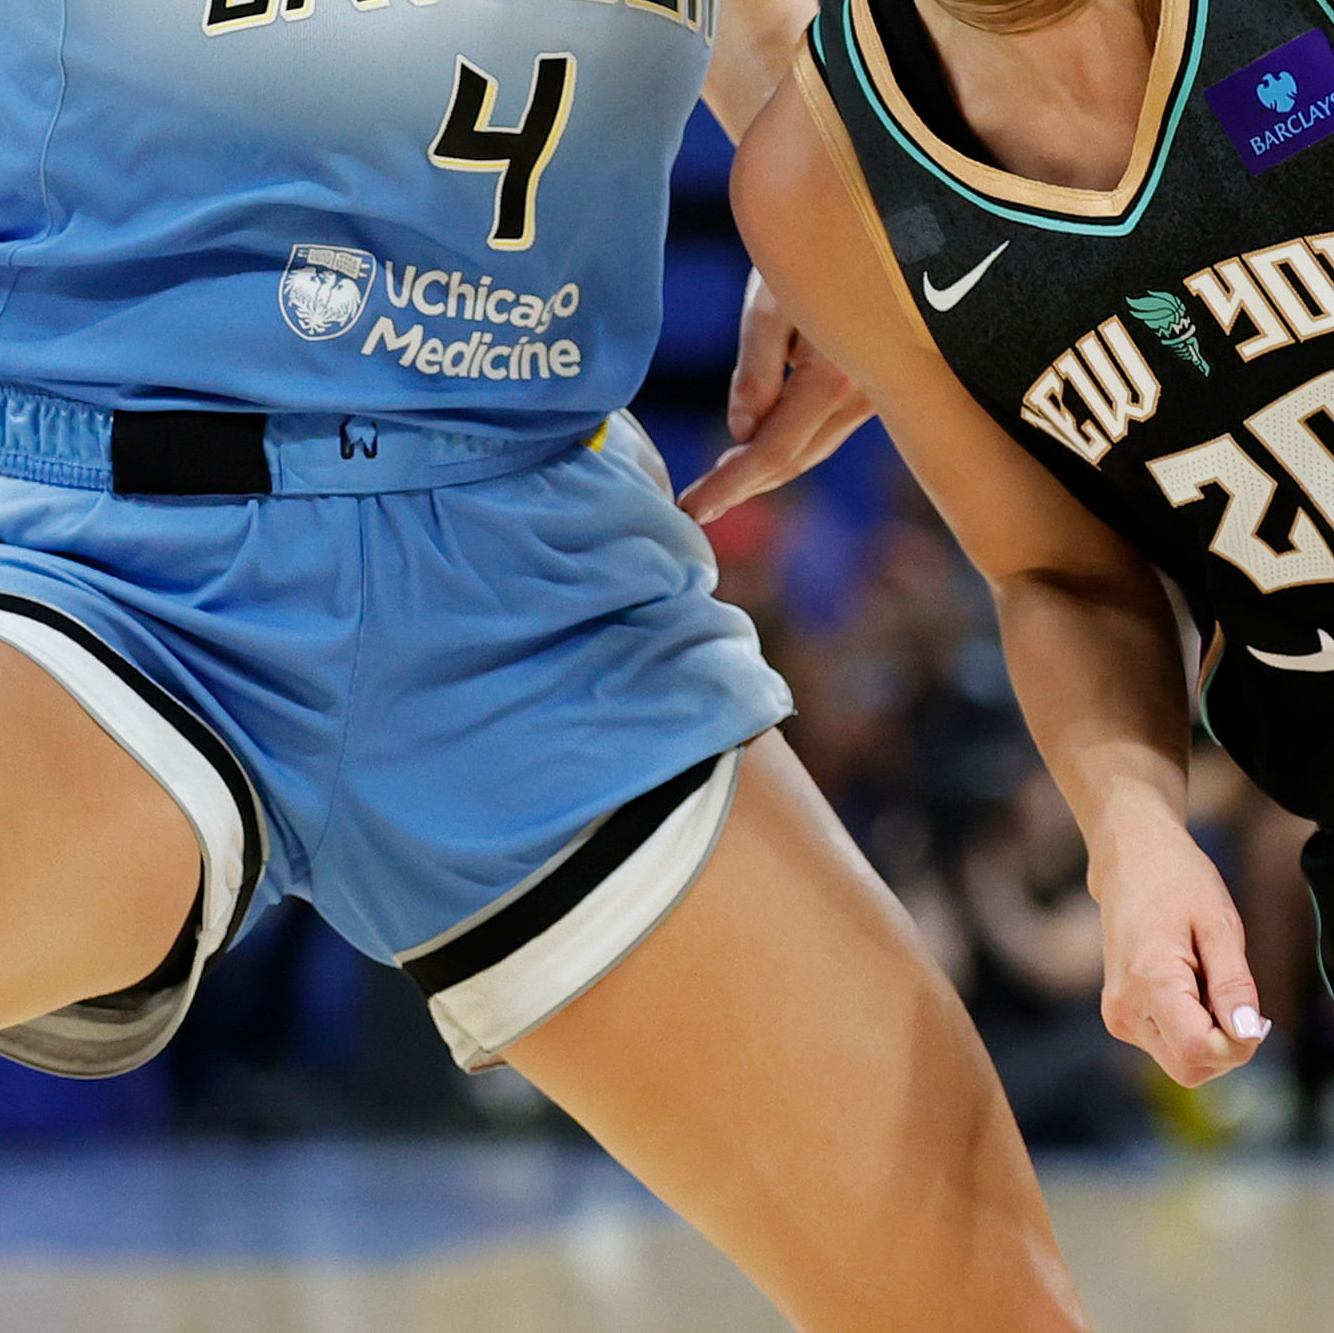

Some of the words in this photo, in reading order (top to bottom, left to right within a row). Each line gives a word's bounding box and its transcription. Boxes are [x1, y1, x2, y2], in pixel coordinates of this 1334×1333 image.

[428, 52, 578, 252] 4
[385, 260, 580, 333] UChicago
[361, 316, 582, 380] Medicine
